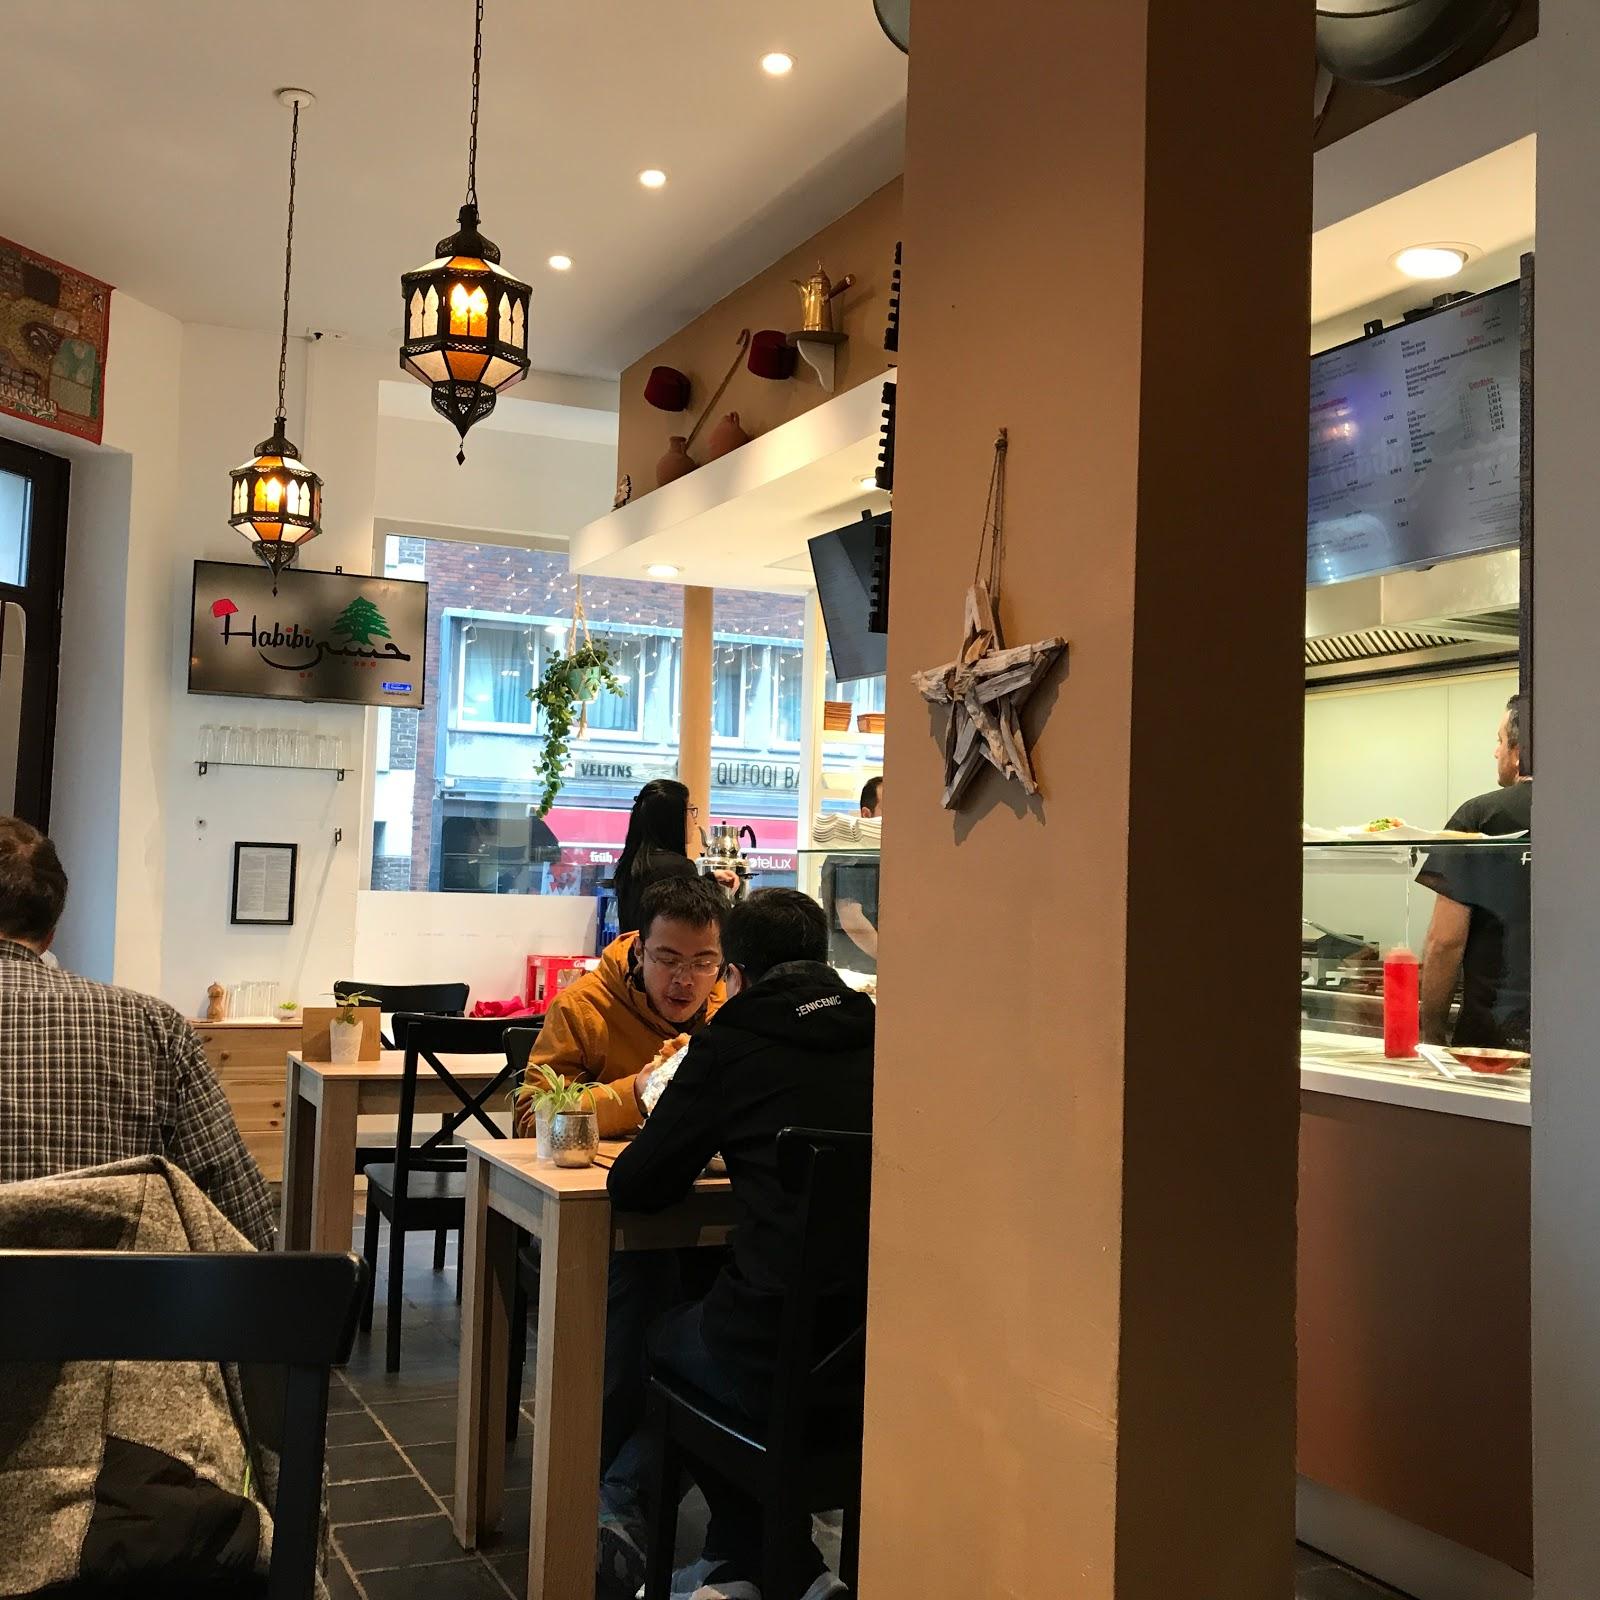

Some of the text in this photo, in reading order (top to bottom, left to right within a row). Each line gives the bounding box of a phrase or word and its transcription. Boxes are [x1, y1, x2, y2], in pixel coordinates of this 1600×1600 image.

[220, 614, 314, 648] Habibi
[581, 763, 632, 778] VELTINS
[717, 762, 777, 788] QUTOQI
[795, 995, 842, 1016] ENICENIC
